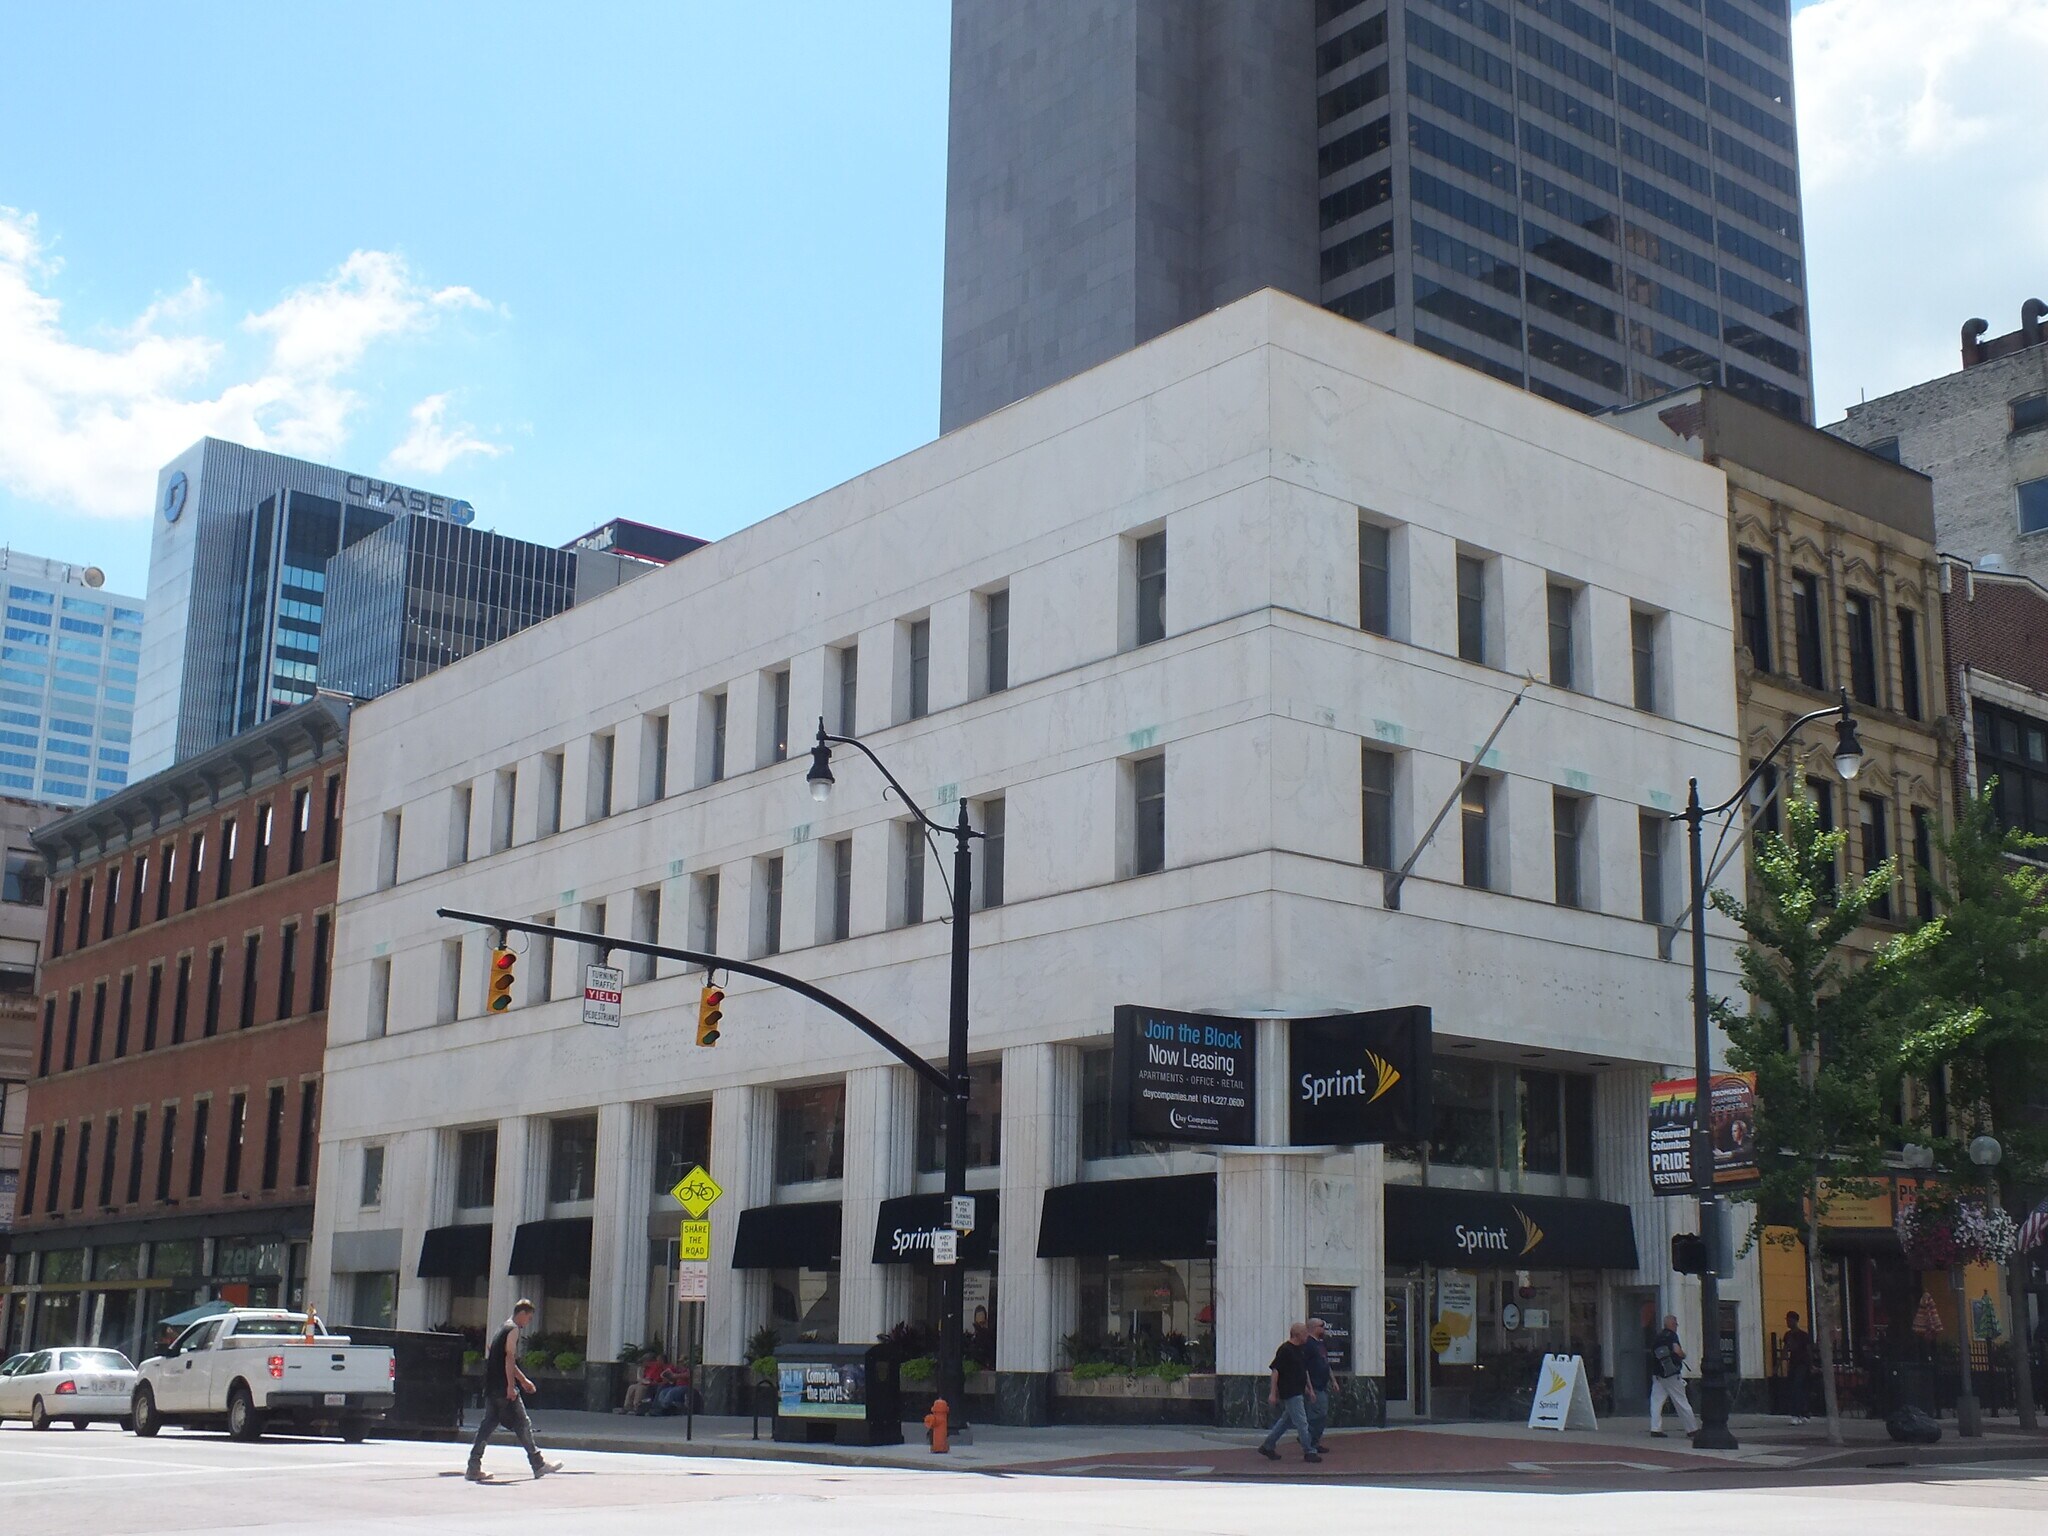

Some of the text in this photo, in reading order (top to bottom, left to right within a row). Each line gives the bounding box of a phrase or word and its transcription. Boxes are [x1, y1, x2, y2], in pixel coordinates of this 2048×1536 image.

[346, 475, 445, 518] CHASE
[592, 970, 618, 982] TURNING
[592, 979, 616, 990] TRAFFIC
[588, 989, 619, 1002] YIELD
[599, 1003, 606, 1011] TO
[585, 1010, 618, 1022] PEDESTRIANS
[1145, 1020, 1242, 1049] Join the Block
[1149, 1043, 1235, 1076] Now Leasing
[1139, 1070, 1245, 1090] APARTMENTS OFFICE RETAIL
[1301, 1068, 1366, 1106] Sprint
[1142, 1088, 1199, 1103] daycompanies.net
[1175, 1113, 1219, 1125] Day Companies
[1650, 1127, 1691, 1140] Stonewall
[1650, 1140, 1691, 1151] Columbus
[1652, 1151, 1691, 1171] PRIDE
[1653, 1171, 1693, 1185] FESTIVAL
[684, 1225, 707, 1234] SHARE
[689, 1236, 702, 1244] THE
[892, 1227, 936, 1256] Sprint
[1455, 1224, 1509, 1255] Sprint
[685, 1247, 705, 1256] ROAD
[807, 1369, 839, 1387] Come join
[807, 1385, 818, 1400] the
[1540, 1401, 1559, 1409] Sprint
